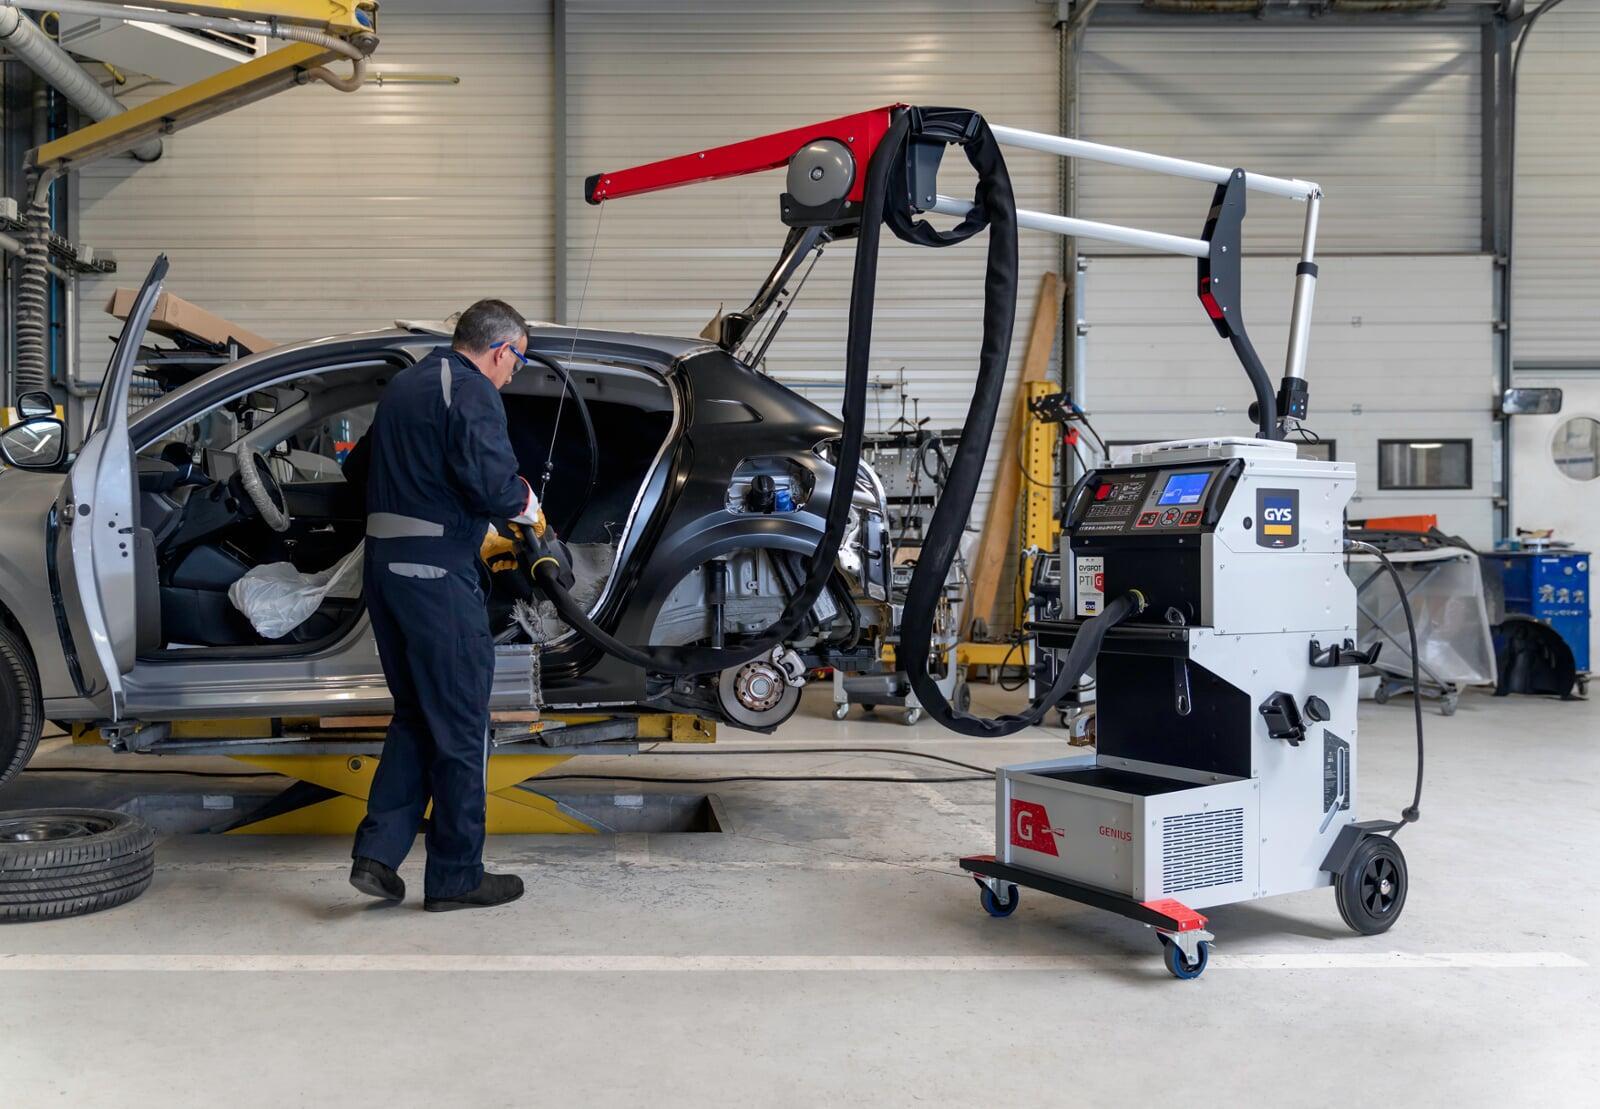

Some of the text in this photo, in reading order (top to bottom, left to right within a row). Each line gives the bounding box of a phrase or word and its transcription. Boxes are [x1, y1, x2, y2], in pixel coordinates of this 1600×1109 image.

[1264, 507, 1292, 521] GYS
[1017, 810, 1132, 842] G GENIUS
